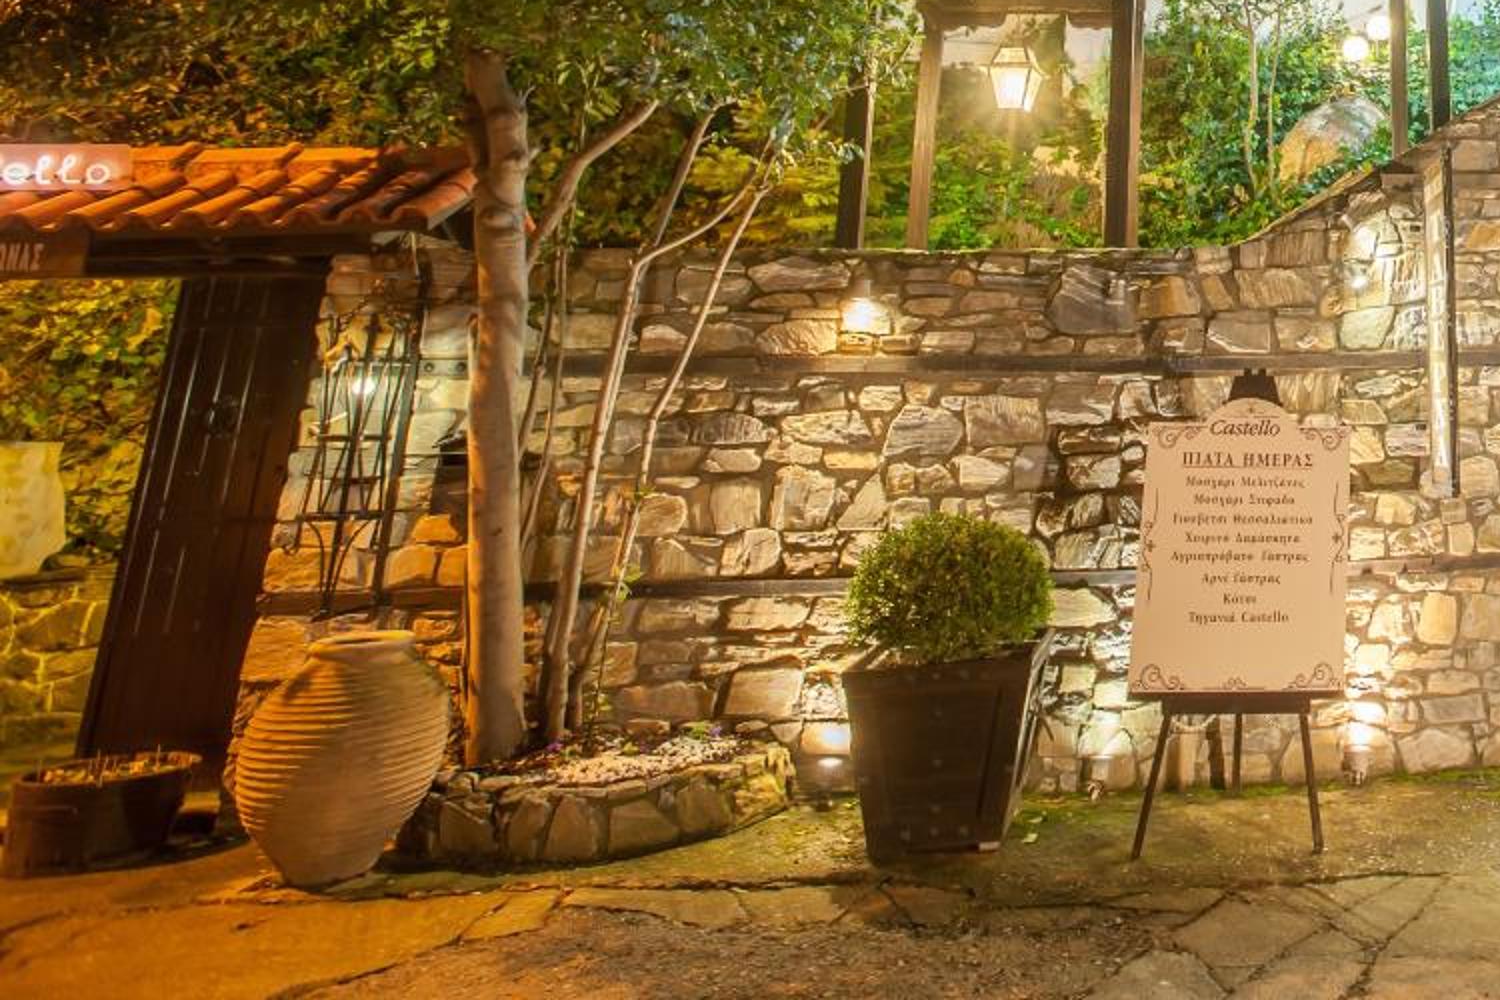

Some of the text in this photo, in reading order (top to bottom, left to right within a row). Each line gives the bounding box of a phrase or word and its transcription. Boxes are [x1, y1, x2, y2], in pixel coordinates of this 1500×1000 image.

[1209, 419, 1280, 438] Castello
[1182, 451, 1313, 468] ΠΙΑΤΑ ΗΜΕΡΑΣ
[1240, 609, 1290, 624] Castello
